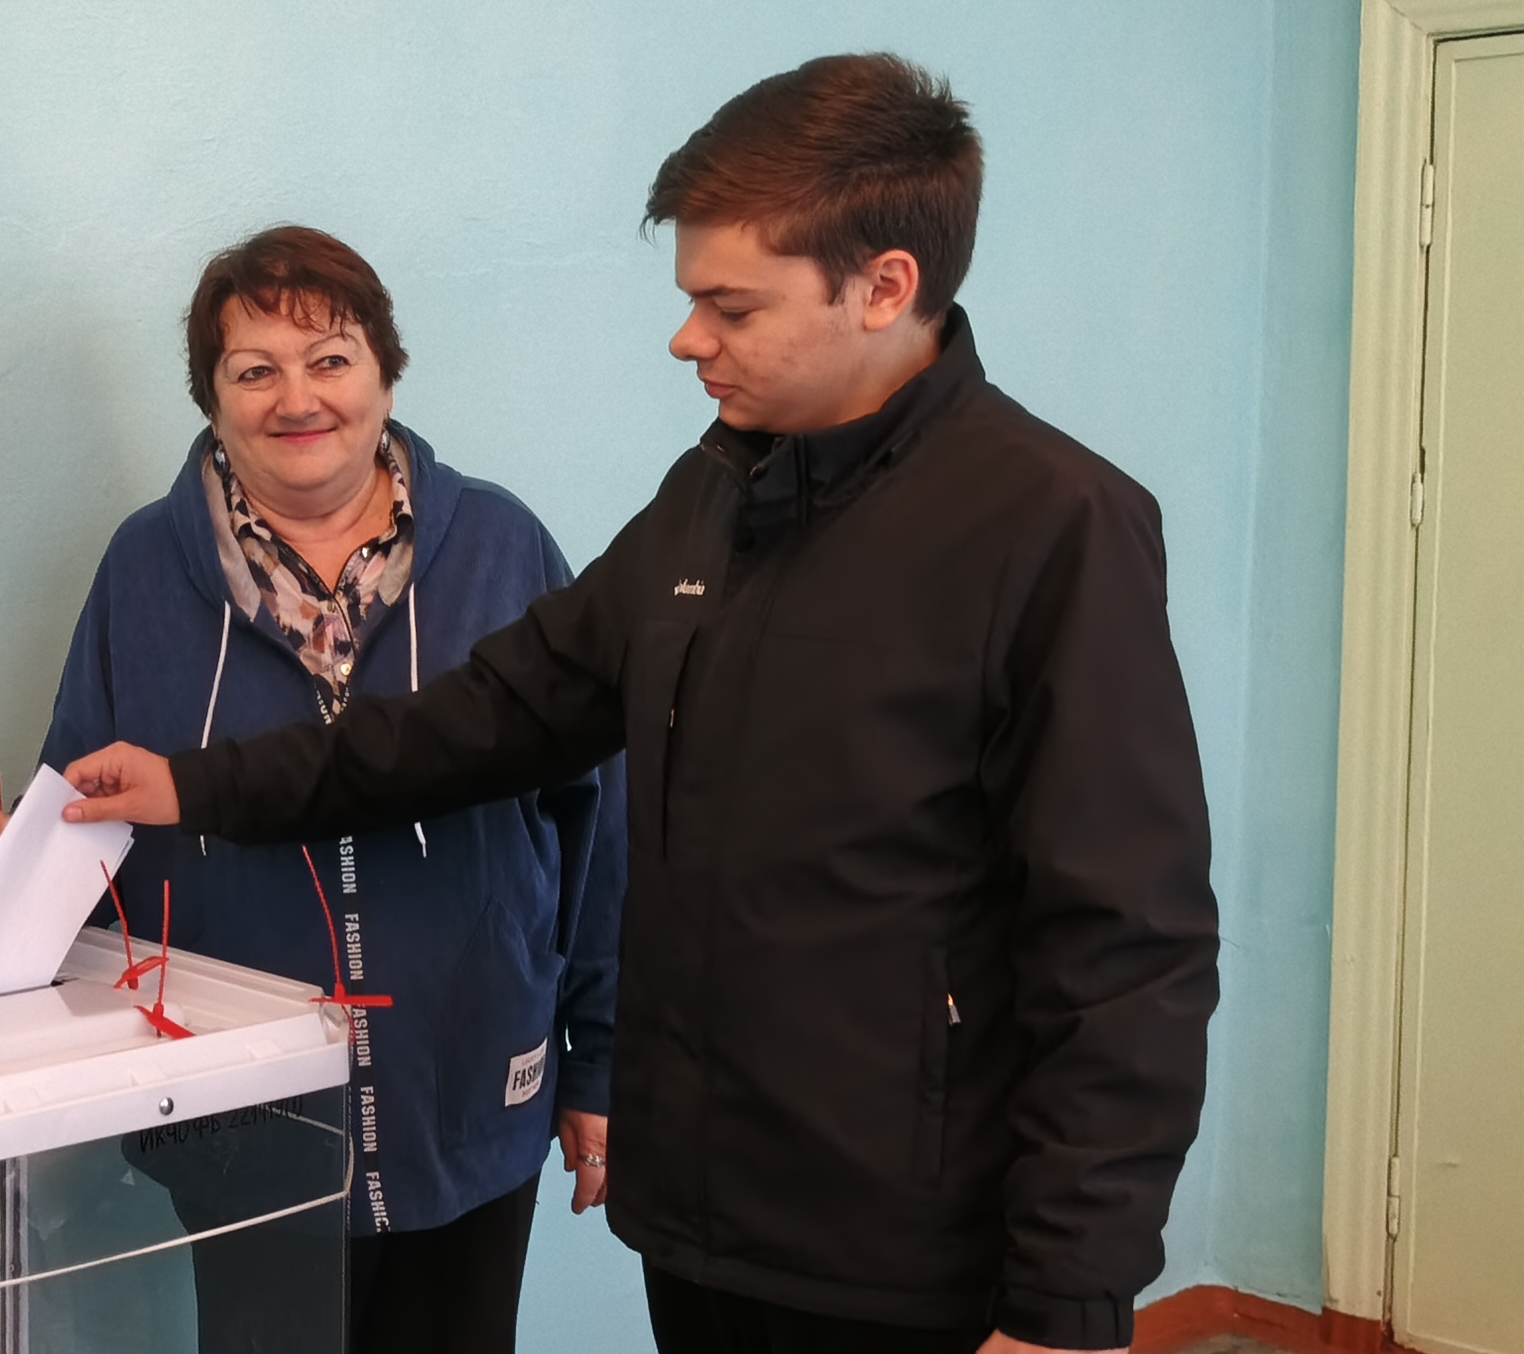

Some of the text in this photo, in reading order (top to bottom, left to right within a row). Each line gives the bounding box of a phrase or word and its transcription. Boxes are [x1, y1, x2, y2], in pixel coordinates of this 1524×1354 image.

[344, 913, 364, 981] FASHION
[352, 1002, 372, 1067] ASHION
[360, 1086, 378, 1153] FASHION
